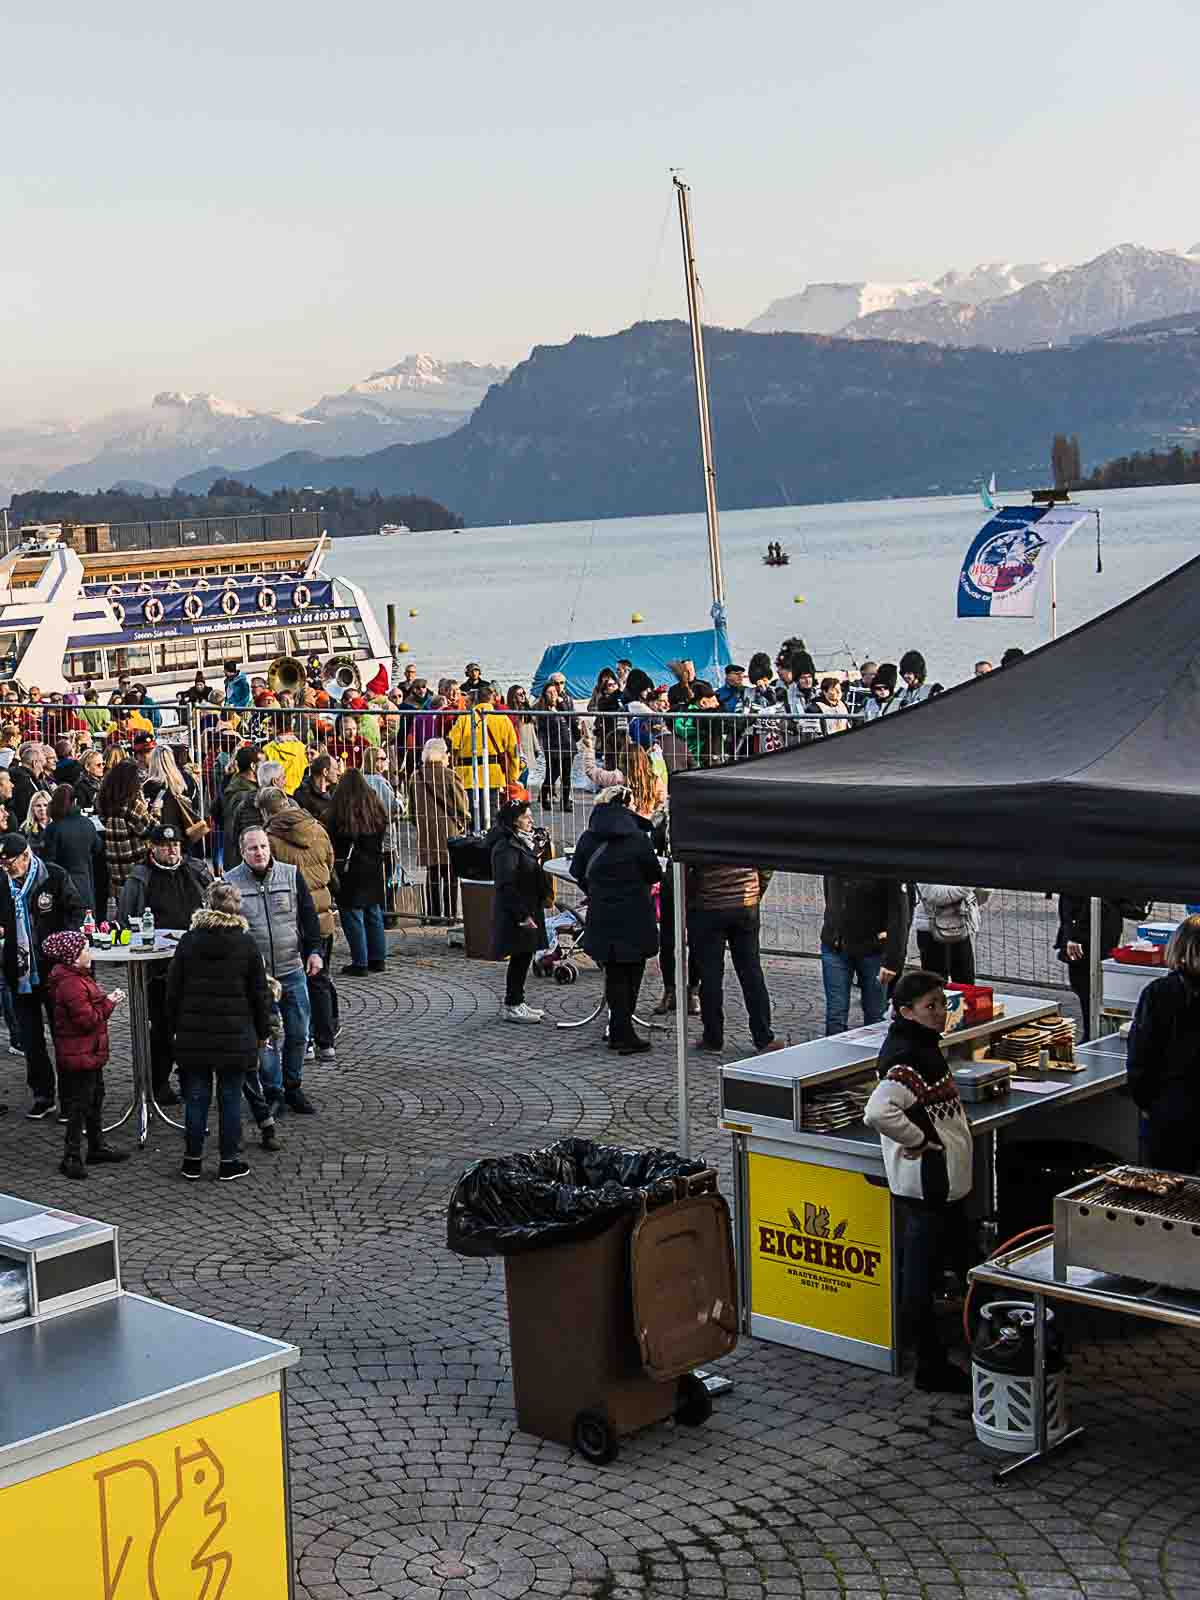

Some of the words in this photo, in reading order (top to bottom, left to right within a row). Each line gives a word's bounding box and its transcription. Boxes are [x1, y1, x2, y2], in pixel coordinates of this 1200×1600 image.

[288, 615, 301, 624] +41
[303, 613, 312, 623] 41
[314, 612, 328, 621] 410
[759, 1226, 881, 1278] EICHHOF
